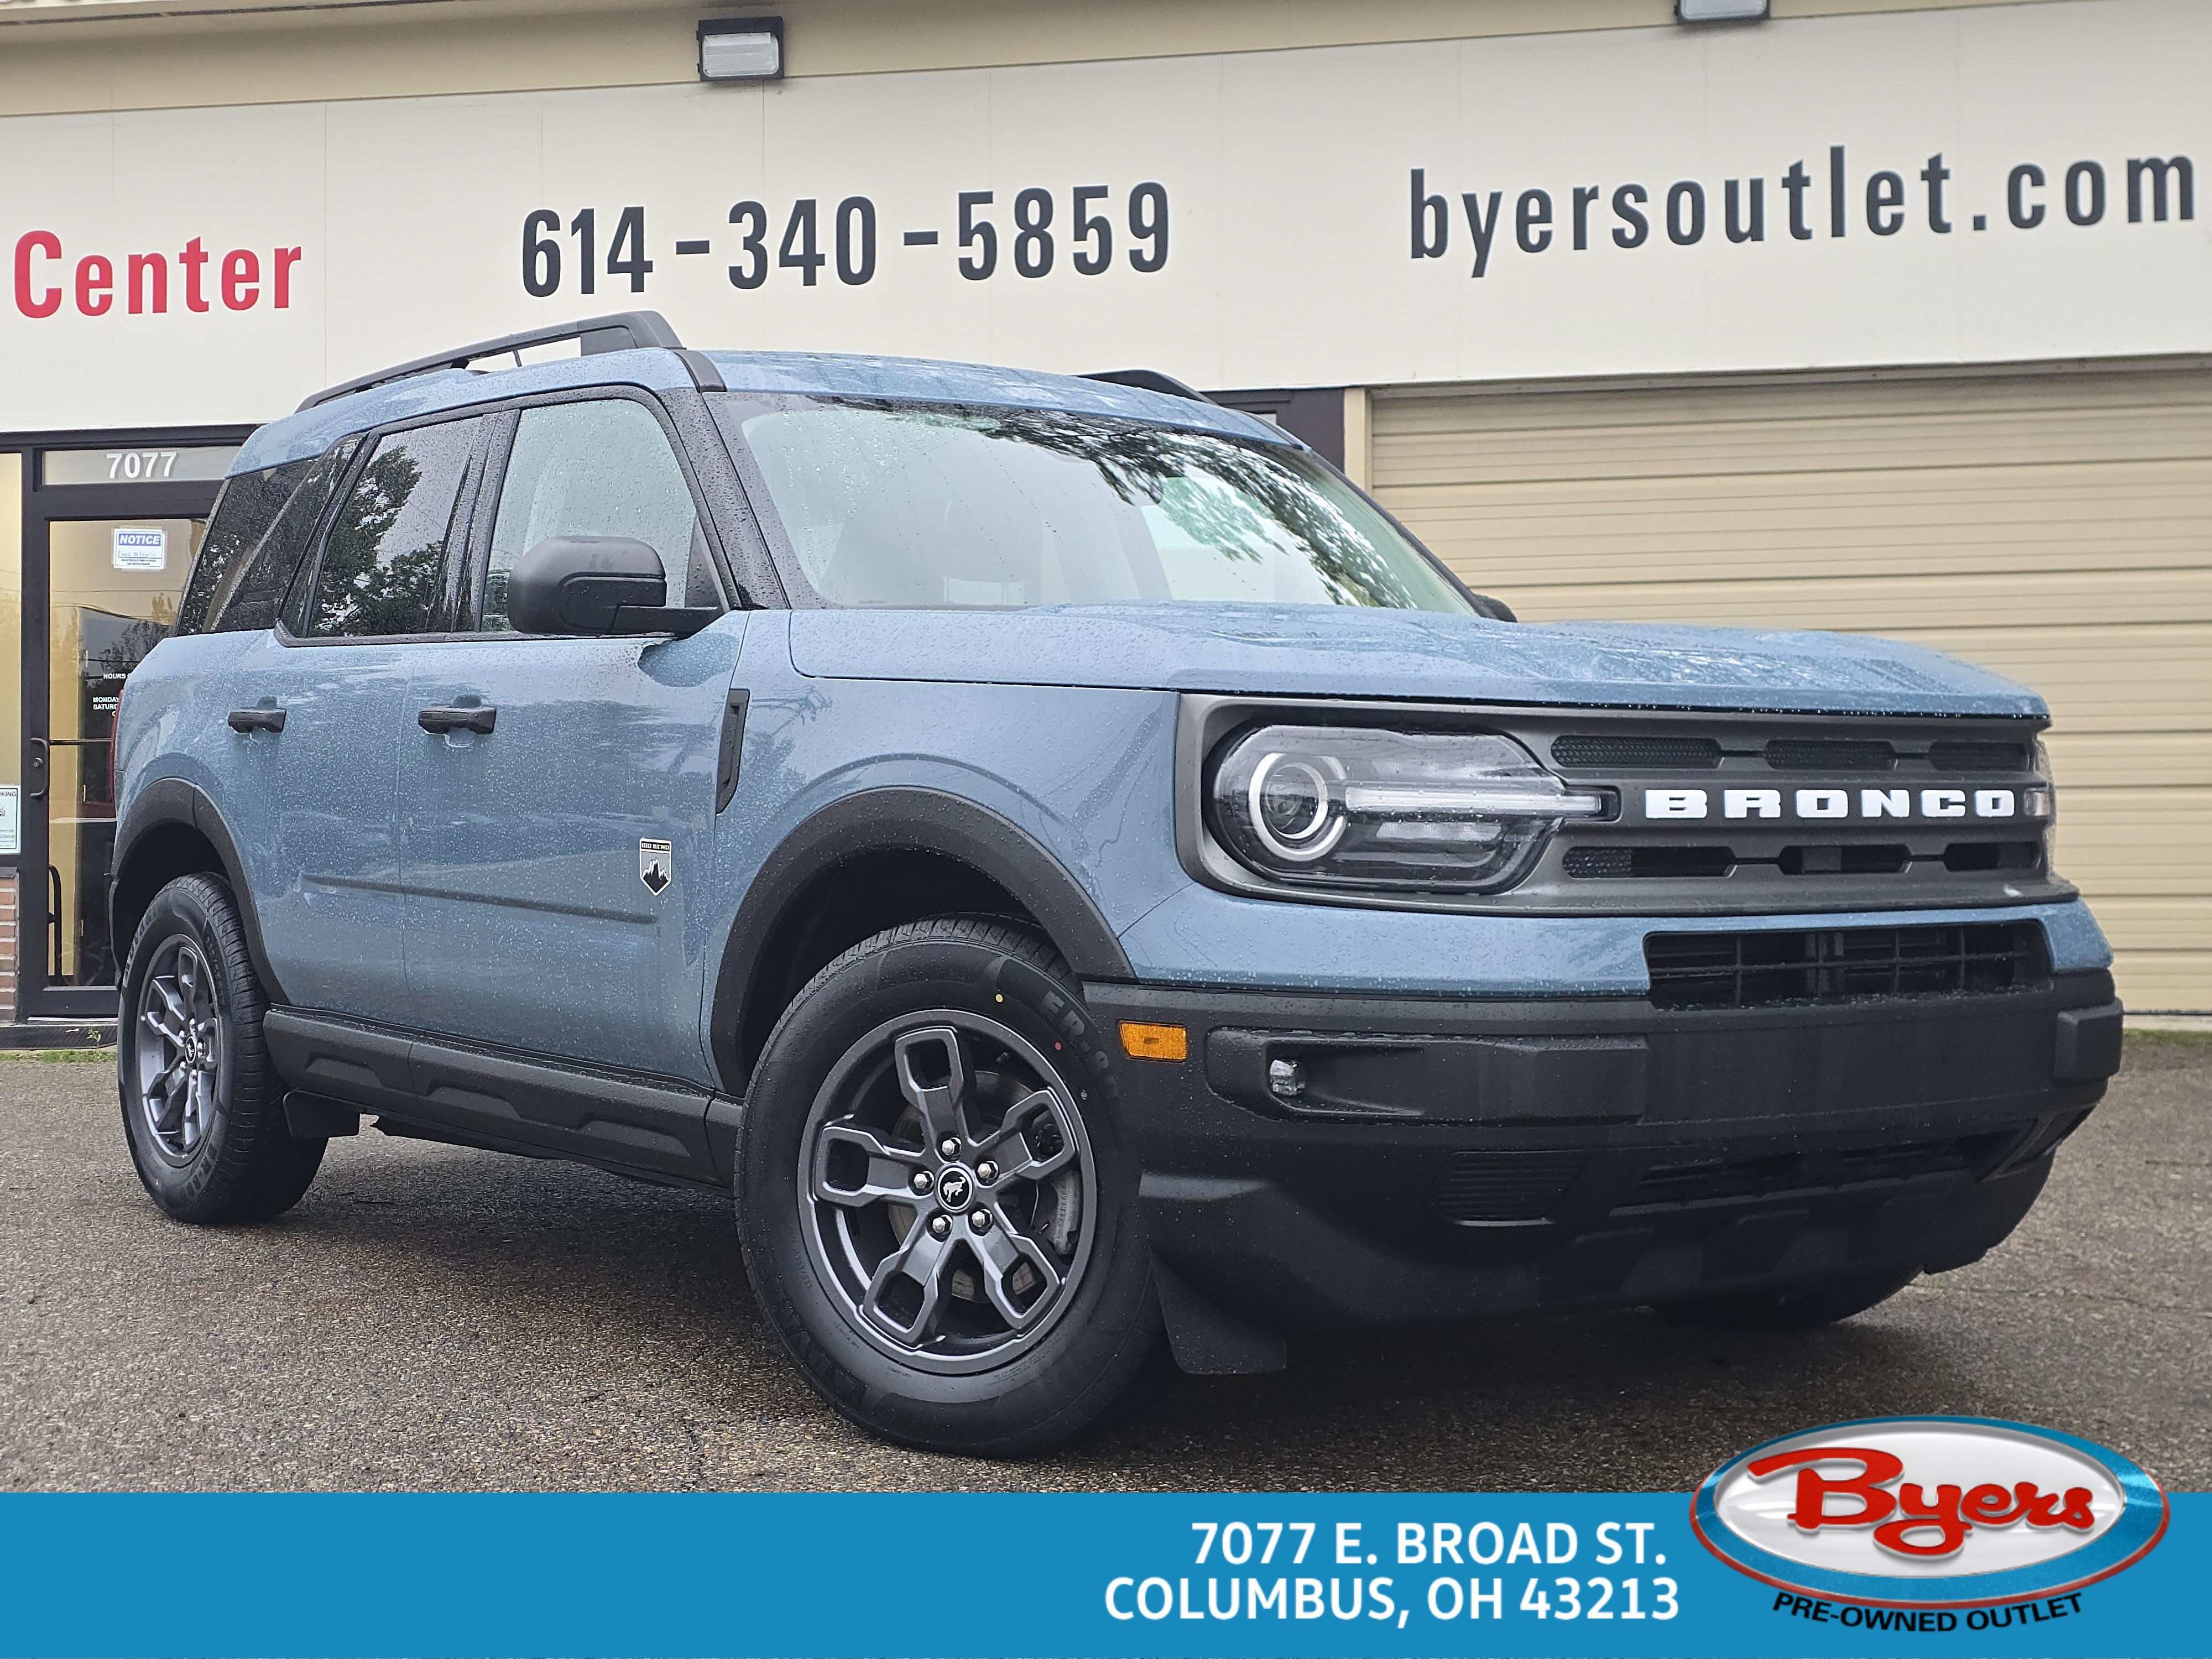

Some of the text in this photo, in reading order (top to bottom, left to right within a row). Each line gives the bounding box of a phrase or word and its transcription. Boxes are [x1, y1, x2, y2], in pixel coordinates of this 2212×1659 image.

[1410, 145, 2194, 278] byersoutlet.com
[14, 230, 301, 319] Center
[107, 452, 177, 478] 7077
[119, 535, 160, 545] NOTICE
[1645, 789, 2015, 818] BRONCO
